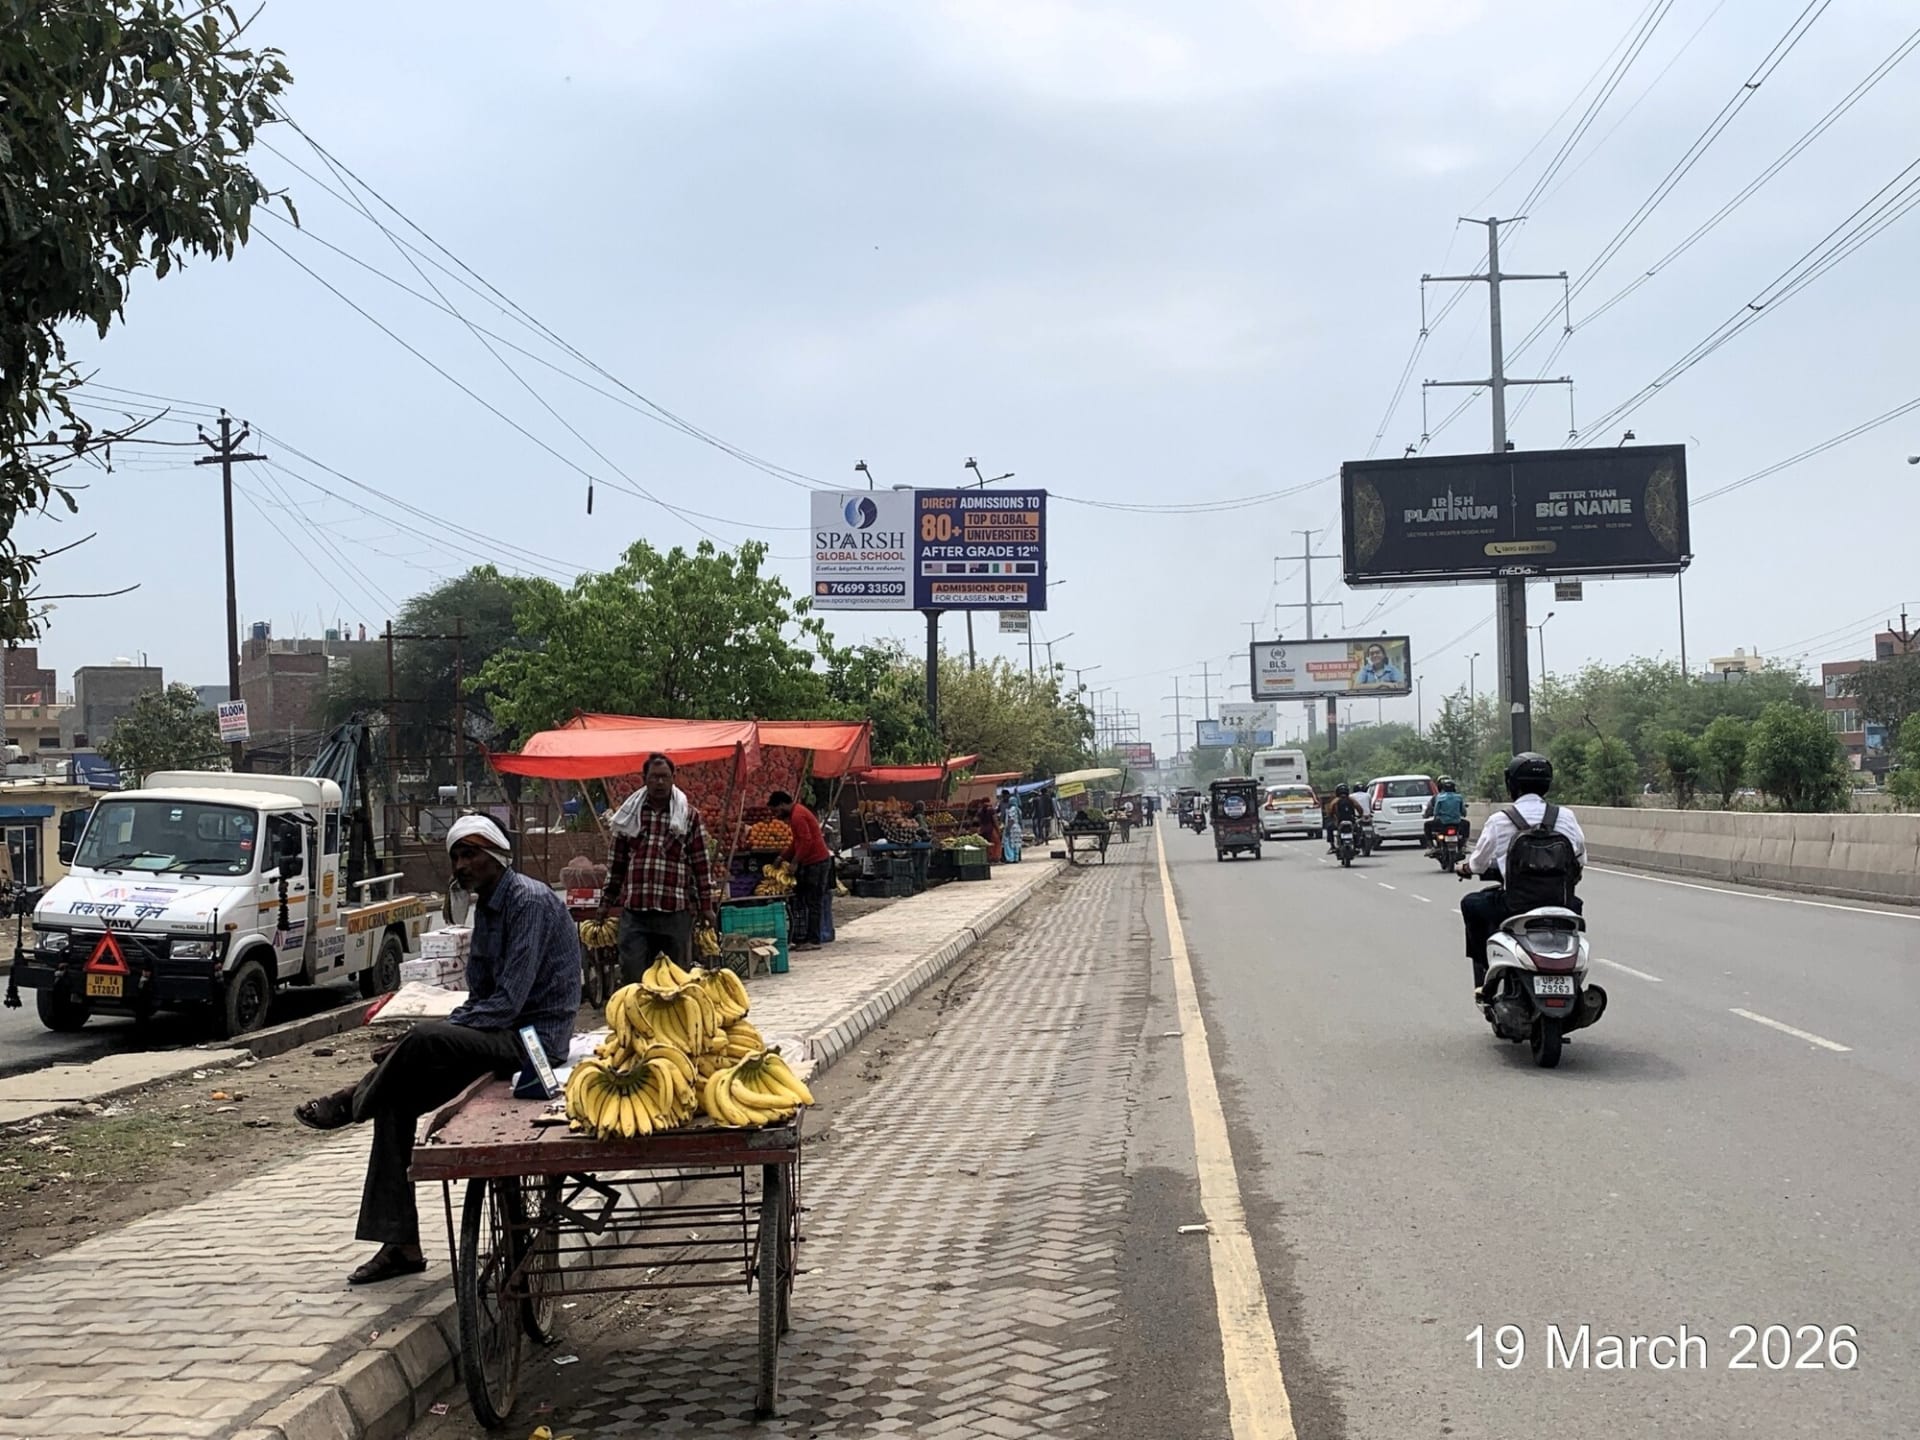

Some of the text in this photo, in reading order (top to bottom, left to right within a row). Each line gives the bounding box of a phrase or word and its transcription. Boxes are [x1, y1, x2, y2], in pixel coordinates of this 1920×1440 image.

[1549, 489, 1617, 500] BETTER THAN
[922, 496, 1040, 509] DIRECT ADMISSIONS TO
[1404, 503, 1498, 523] PLATINUM
[1535, 499, 1632, 518] BIG NAME
[967, 513, 1029, 525] TOP GLOBAL
[921, 513, 962, 542] 80+
[967, 528, 1036, 541] UNIVERSITIES
[816, 551, 905, 561] GLOBAL SCHOOL
[922, 545, 1039, 557] AFTER GRADE 12th
[831, 583, 903, 594] 76699 33509
[936, 584, 1025, 592] ADMISSIONS OPEN
[1269, 660, 1287, 669] BLS
[220, 703, 245, 718] BLOOM
[107, 920, 132, 929] TATA
[94, 975, 105, 985] UP
[1542, 976, 1566, 985] UP23
